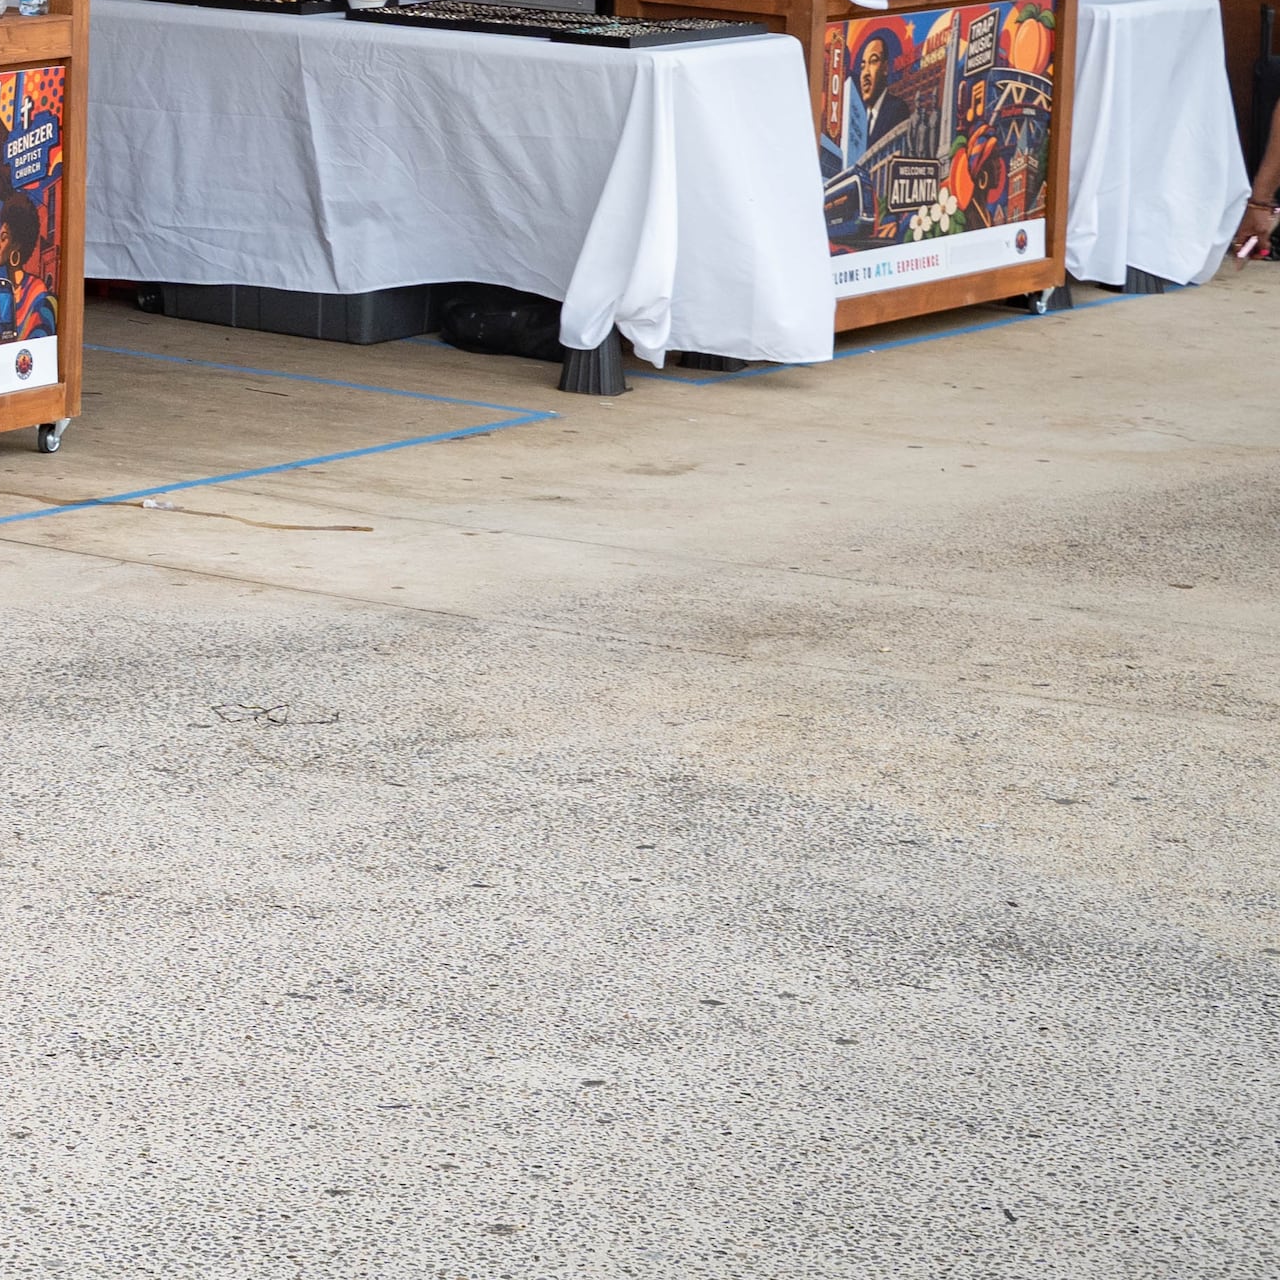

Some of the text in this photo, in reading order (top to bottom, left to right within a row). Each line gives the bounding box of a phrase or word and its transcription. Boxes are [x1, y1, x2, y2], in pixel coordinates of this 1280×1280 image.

[971, 16, 994, 40] TRAP
[968, 33, 993, 57] MUSIC
[967, 49, 992, 71] MUSEUM
[830, 48, 841, 123] FOX
[7, 122, 54, 159] EBENEZER
[14, 148, 42, 167] BAPTIST
[15, 162, 41, 180] CHURCH
[898, 166, 935, 176] WELCOME TO
[891, 178, 938, 205] ATLANTA
[863, 267, 871, 279] TO
[875, 261, 893, 276] ATL
[897, 254, 940, 273] EXPERIENCE
